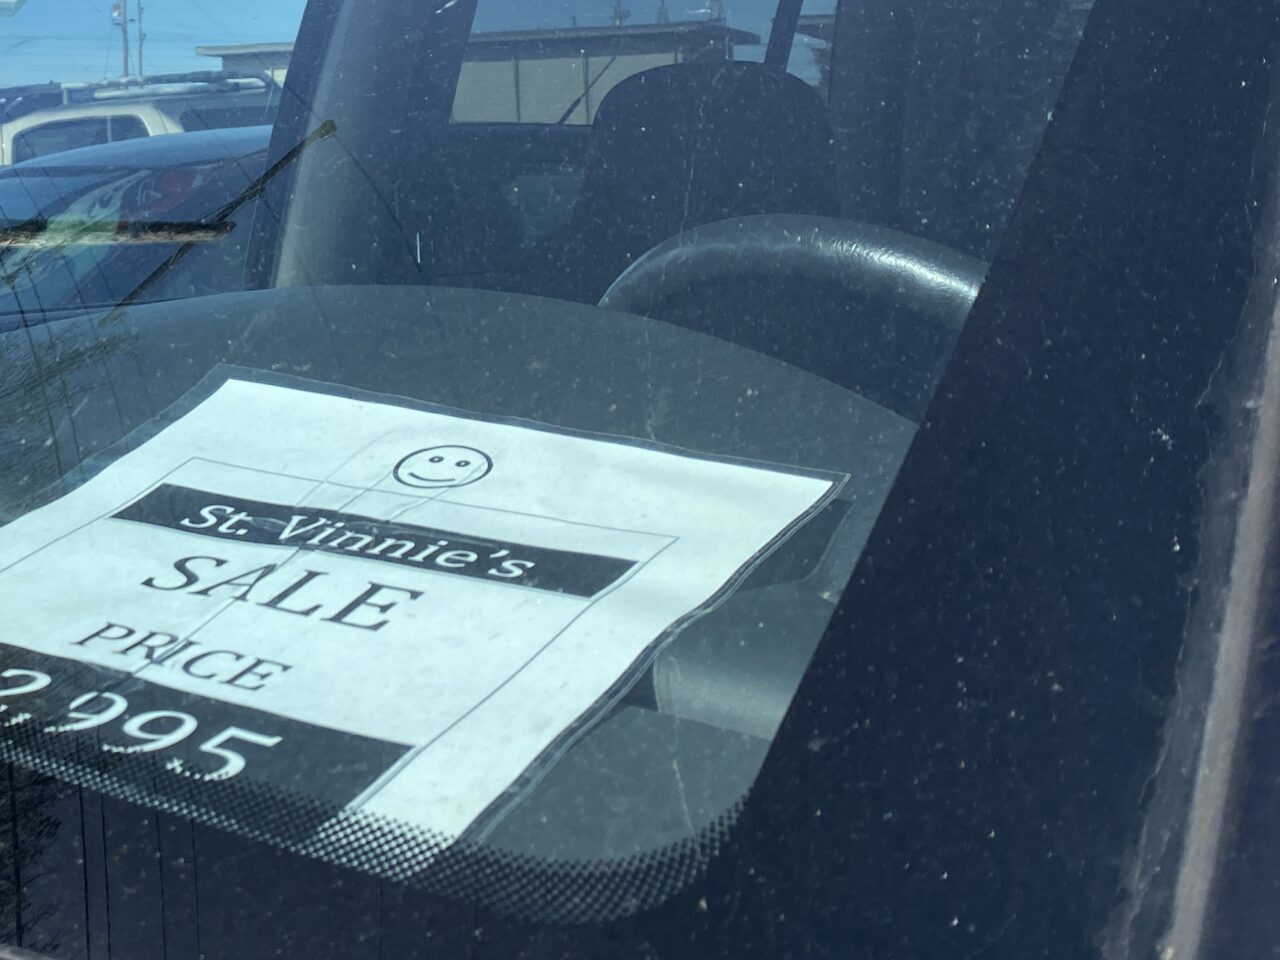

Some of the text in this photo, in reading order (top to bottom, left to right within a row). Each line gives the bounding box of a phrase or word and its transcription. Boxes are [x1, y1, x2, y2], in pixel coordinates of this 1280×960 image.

[180, 503, 536, 580] St. Vinnie's
[140, 555, 426, 633] SALE
[71, 622, 294, 692] PRICE
